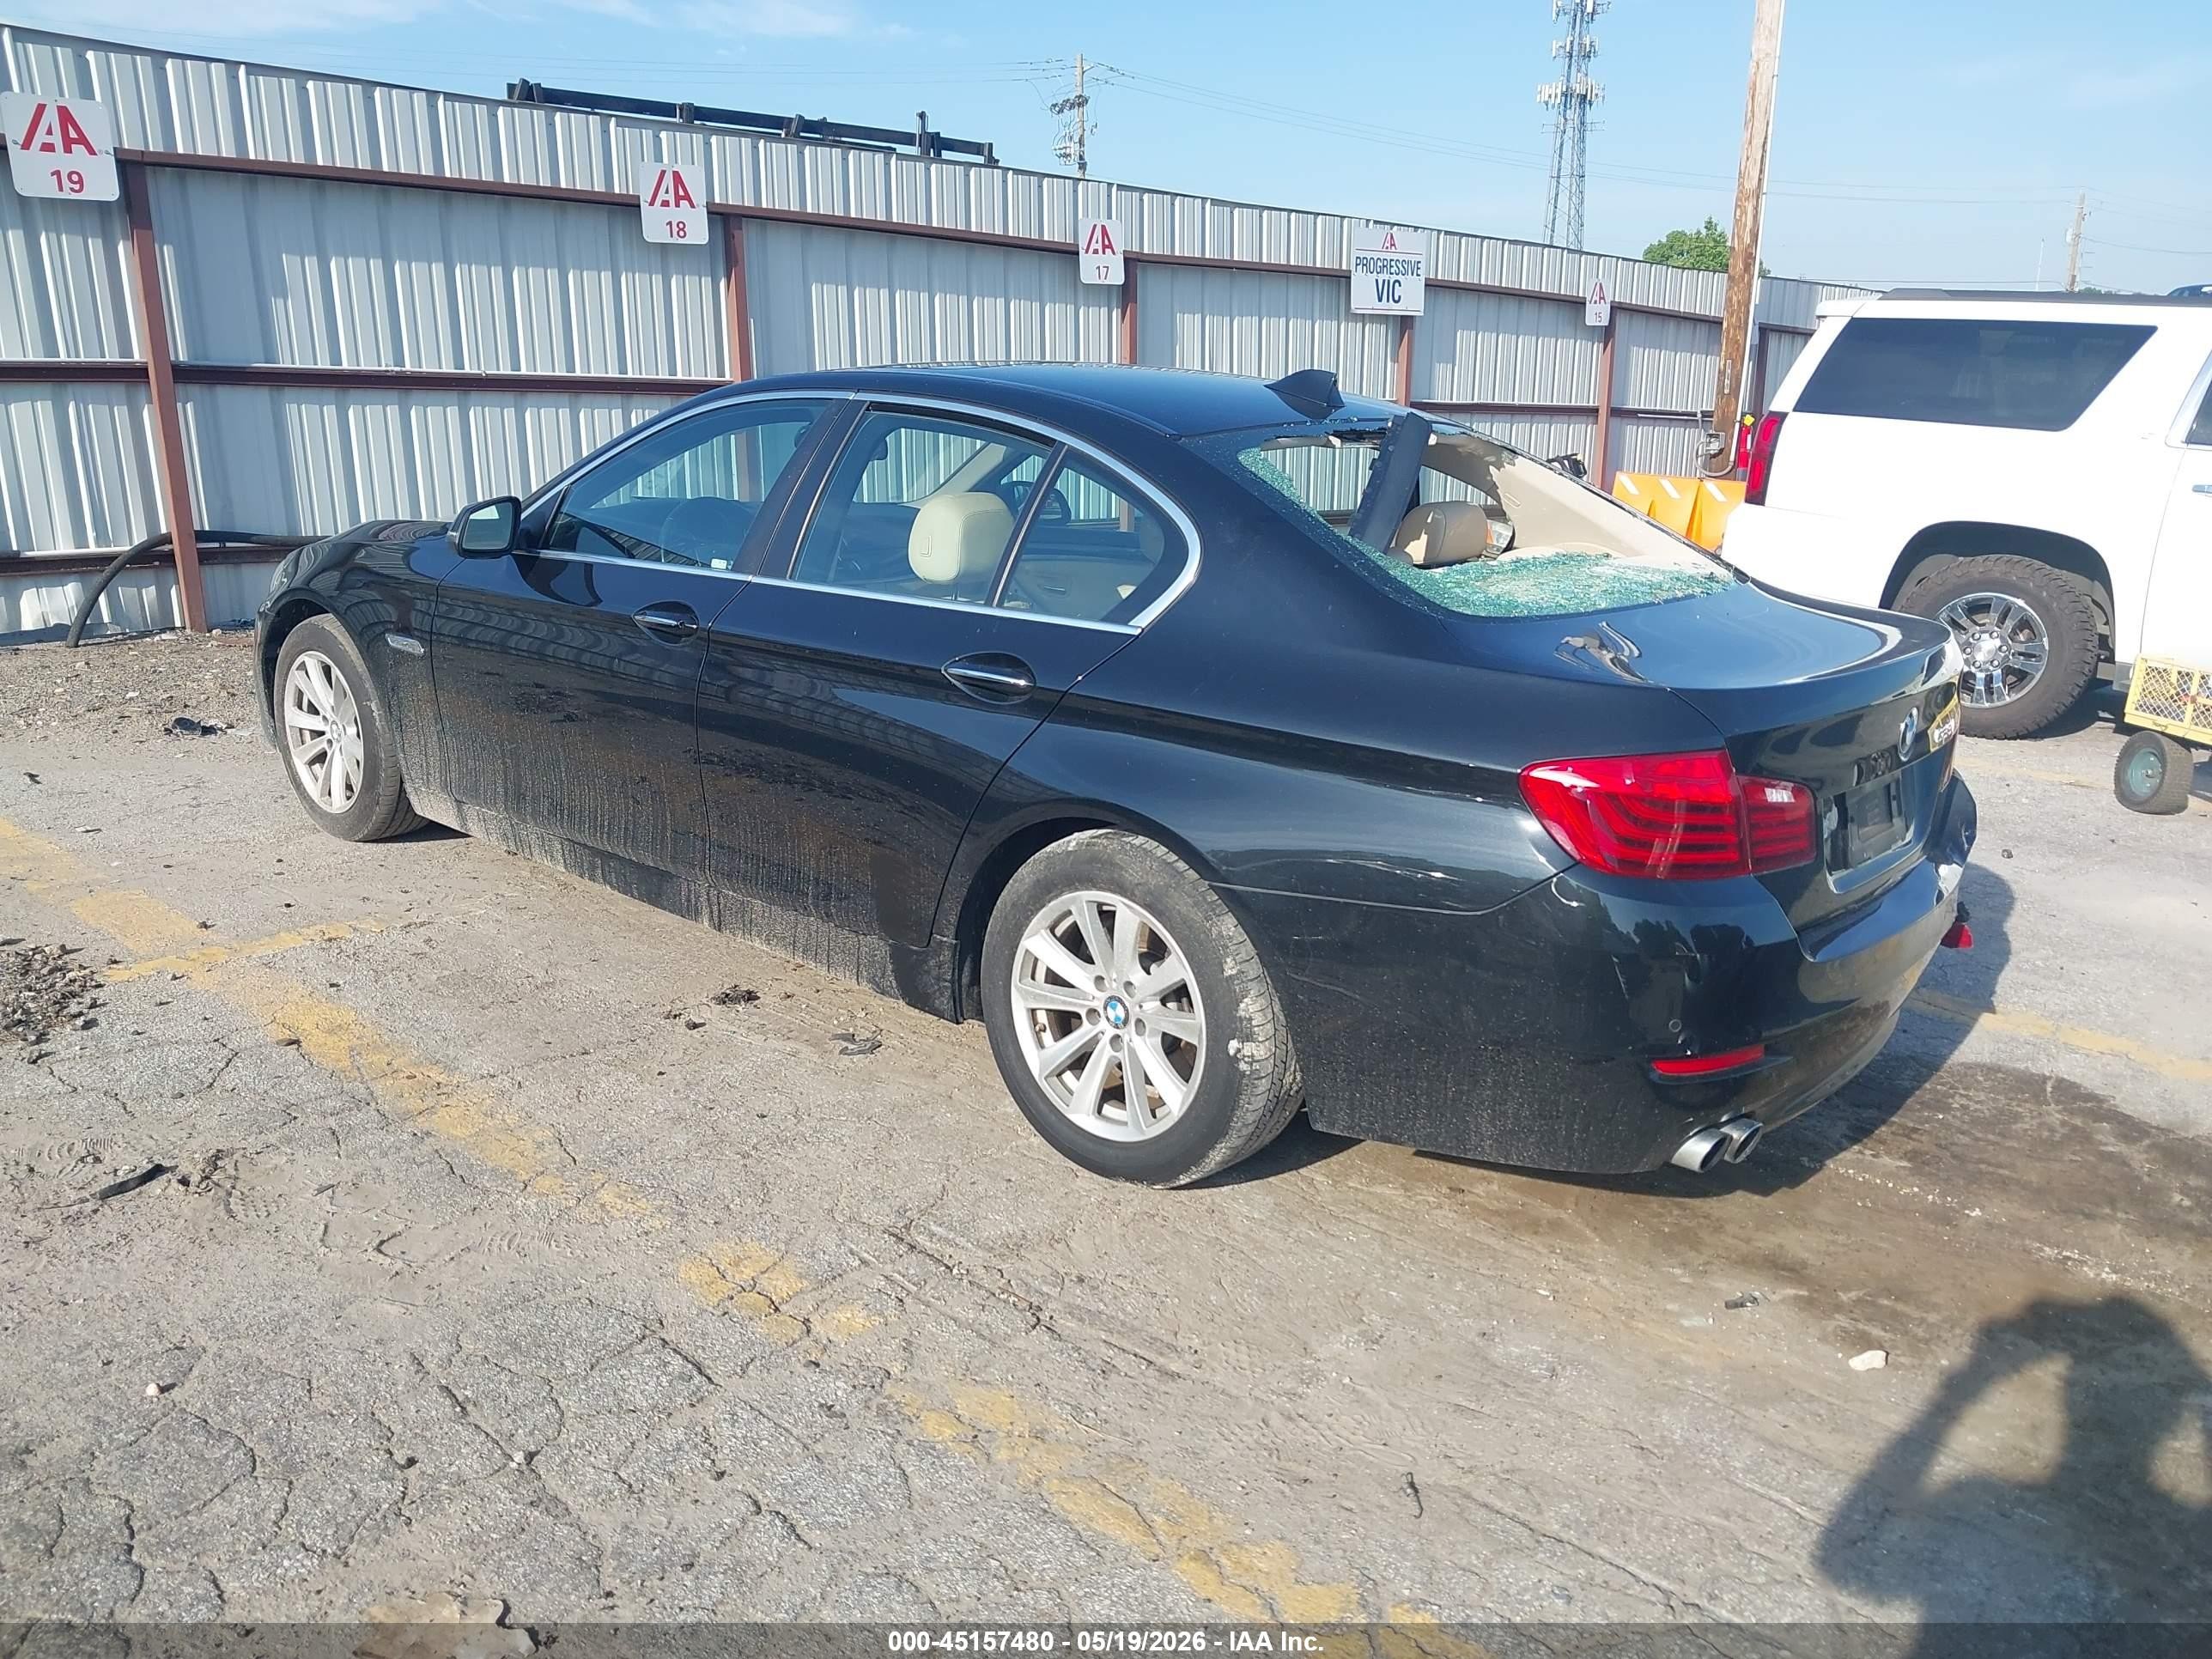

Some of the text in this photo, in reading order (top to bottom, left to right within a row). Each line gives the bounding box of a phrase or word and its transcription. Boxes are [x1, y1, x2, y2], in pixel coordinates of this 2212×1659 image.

[50, 169, 84, 194] 19
[665, 220, 687, 239] 18
[1096, 264, 1109, 280] 17
[1355, 256, 1421, 276] PROGRESSIVE
[1375, 278, 1402, 304] VIC
